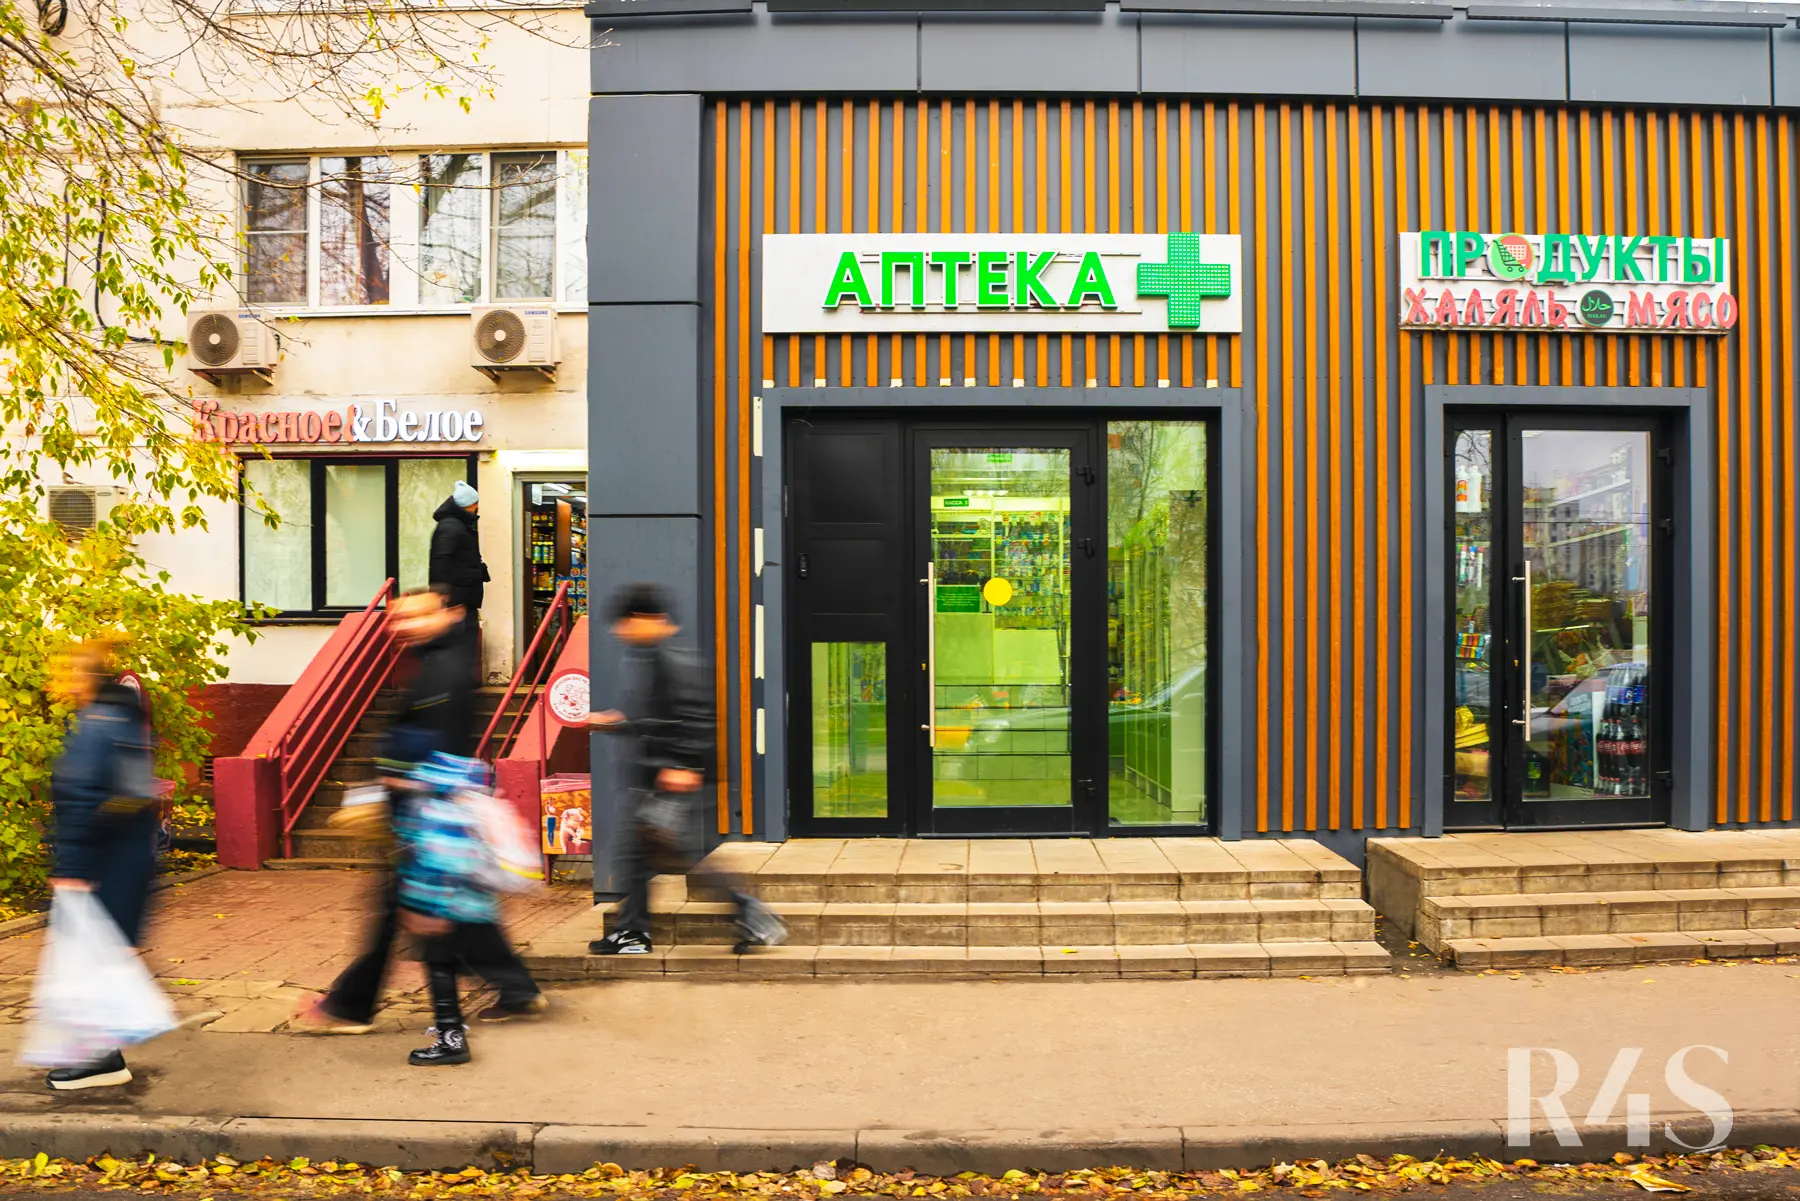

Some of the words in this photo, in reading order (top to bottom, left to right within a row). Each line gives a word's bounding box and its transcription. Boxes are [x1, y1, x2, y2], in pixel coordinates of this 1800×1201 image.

[822, 250, 1118, 309] АПТЕКА
[1404, 287, 1568, 329] ХАЛЯЛЬ
[1628, 290, 1738, 329] МЯСО
[1581, 296, 1611, 312] حلال
